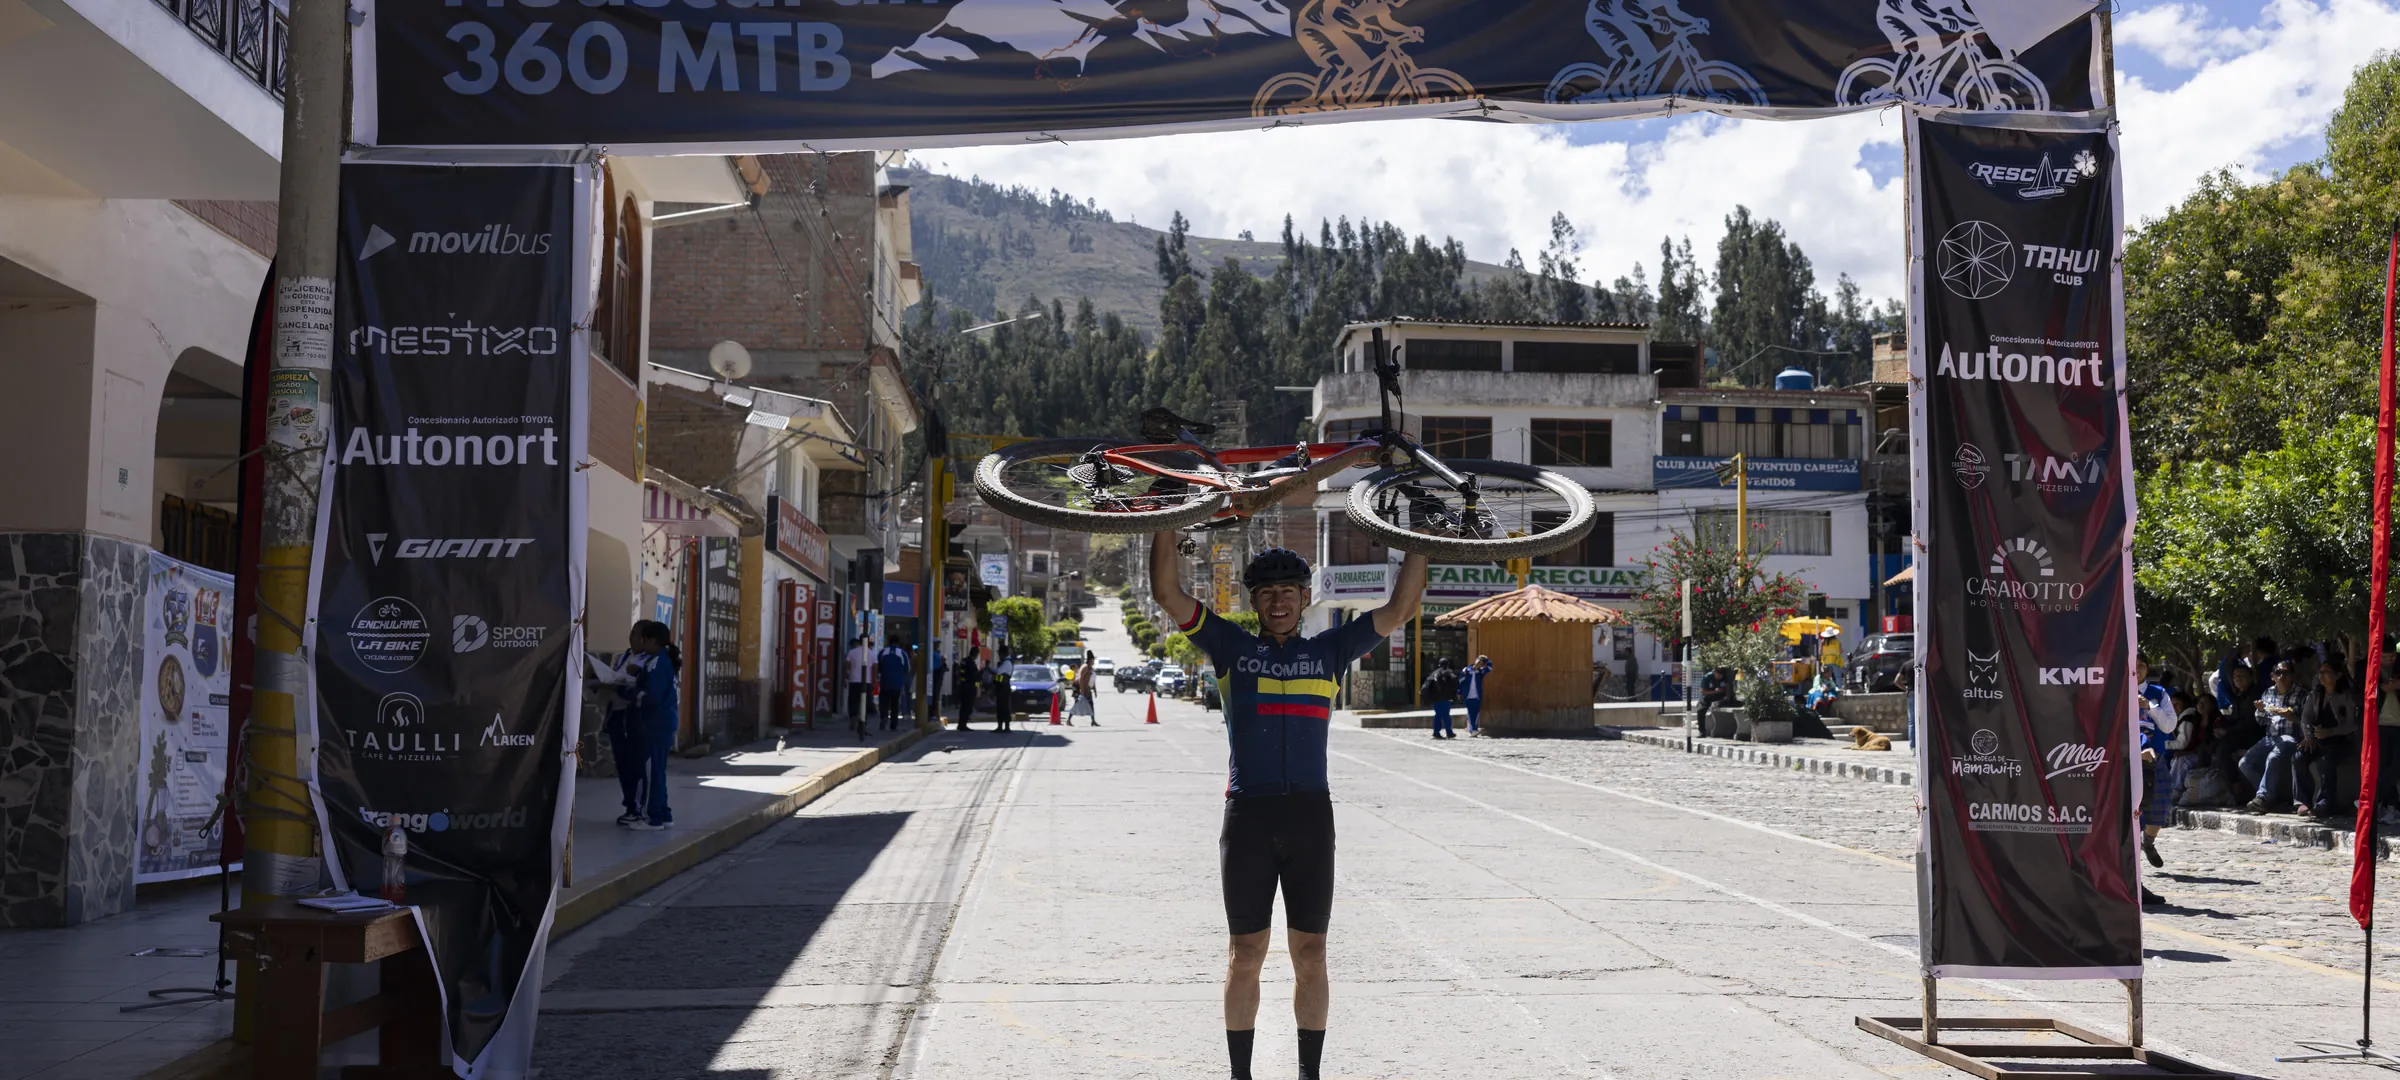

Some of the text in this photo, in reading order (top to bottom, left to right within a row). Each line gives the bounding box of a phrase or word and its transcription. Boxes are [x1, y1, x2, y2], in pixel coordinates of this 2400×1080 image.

[443, 21, 851, 95] 360 MTB
[1969, 158, 2080, 188] RESCATE
[408, 224, 552, 254] movilbus
[2053, 272, 2083, 286] CLUB
[280, 306, 332, 316] SUSPENDIDA
[1990, 334, 2045, 345] Concesionario
[1936, 341, 2104, 387] Autonort
[408, 415, 554, 424] Concesionario Autorizado TOYOTA
[342, 427, 558, 466] Autonort
[1656, 460, 1685, 469] CLUB
[1747, 462, 1802, 472] UVENTUD
[2037, 484, 2080, 492] PIZZERIA
[395, 538, 536, 558] GIANT
[1334, 570, 1386, 584] FARMARECUAY
[1966, 577, 2084, 599] CASAROTTO
[2013, 602, 2080, 612] BOUTIQUE
[492, 626, 547, 640] SPORT
[357, 640, 422, 651] LA BIKE
[493, 640, 539, 648] OUTDOOR
[792, 585, 808, 708] BOTICA
[816, 604, 833, 712] BTICA
[1237, 655, 1324, 677] COLOMBIA
[2039, 667, 2105, 685] KMC
[1963, 687, 2004, 699] altus
[346, 729, 460, 752] TAULLI
[493, 734, 535, 746] LAKEN
[2046, 742, 2108, 775] Mag
[1952, 760, 2022, 778] Mamawito
[1969, 802, 2092, 823] CARMOS S.A.C.
